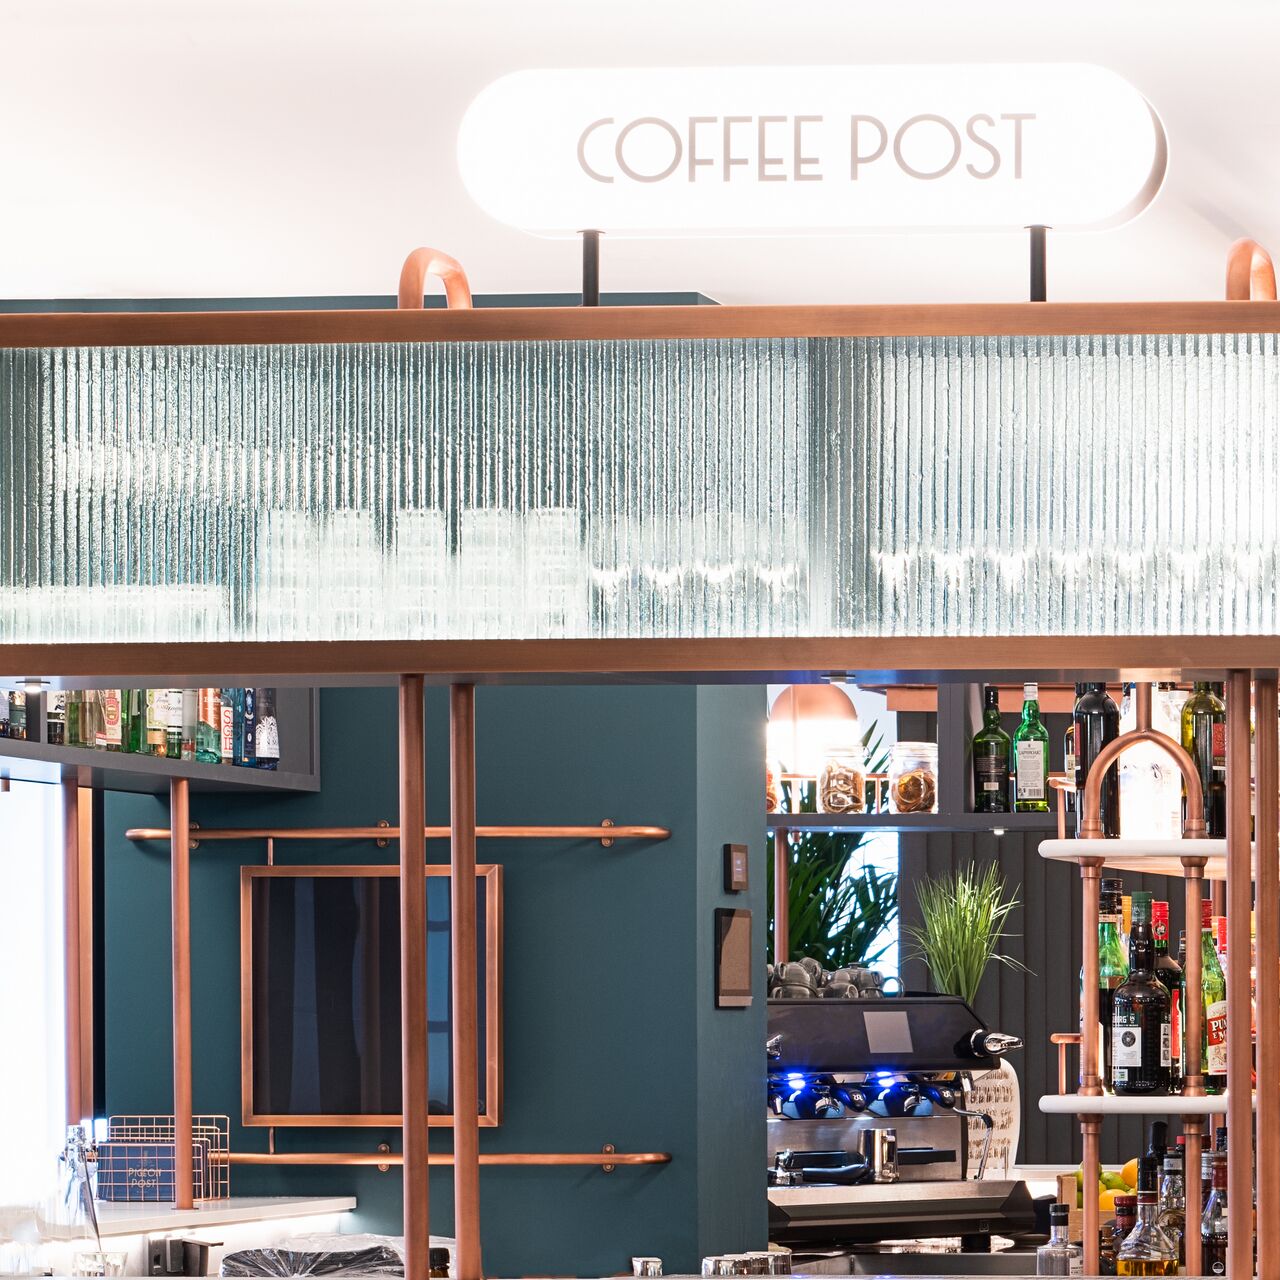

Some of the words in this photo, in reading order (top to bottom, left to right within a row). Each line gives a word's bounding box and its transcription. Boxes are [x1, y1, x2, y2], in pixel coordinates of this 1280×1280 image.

[576, 115, 824, 184] COFFEE
[849, 112, 1038, 182] POST
[128, 1167, 162, 1177] PIGEON
[131, 1178, 157, 1188] POST
